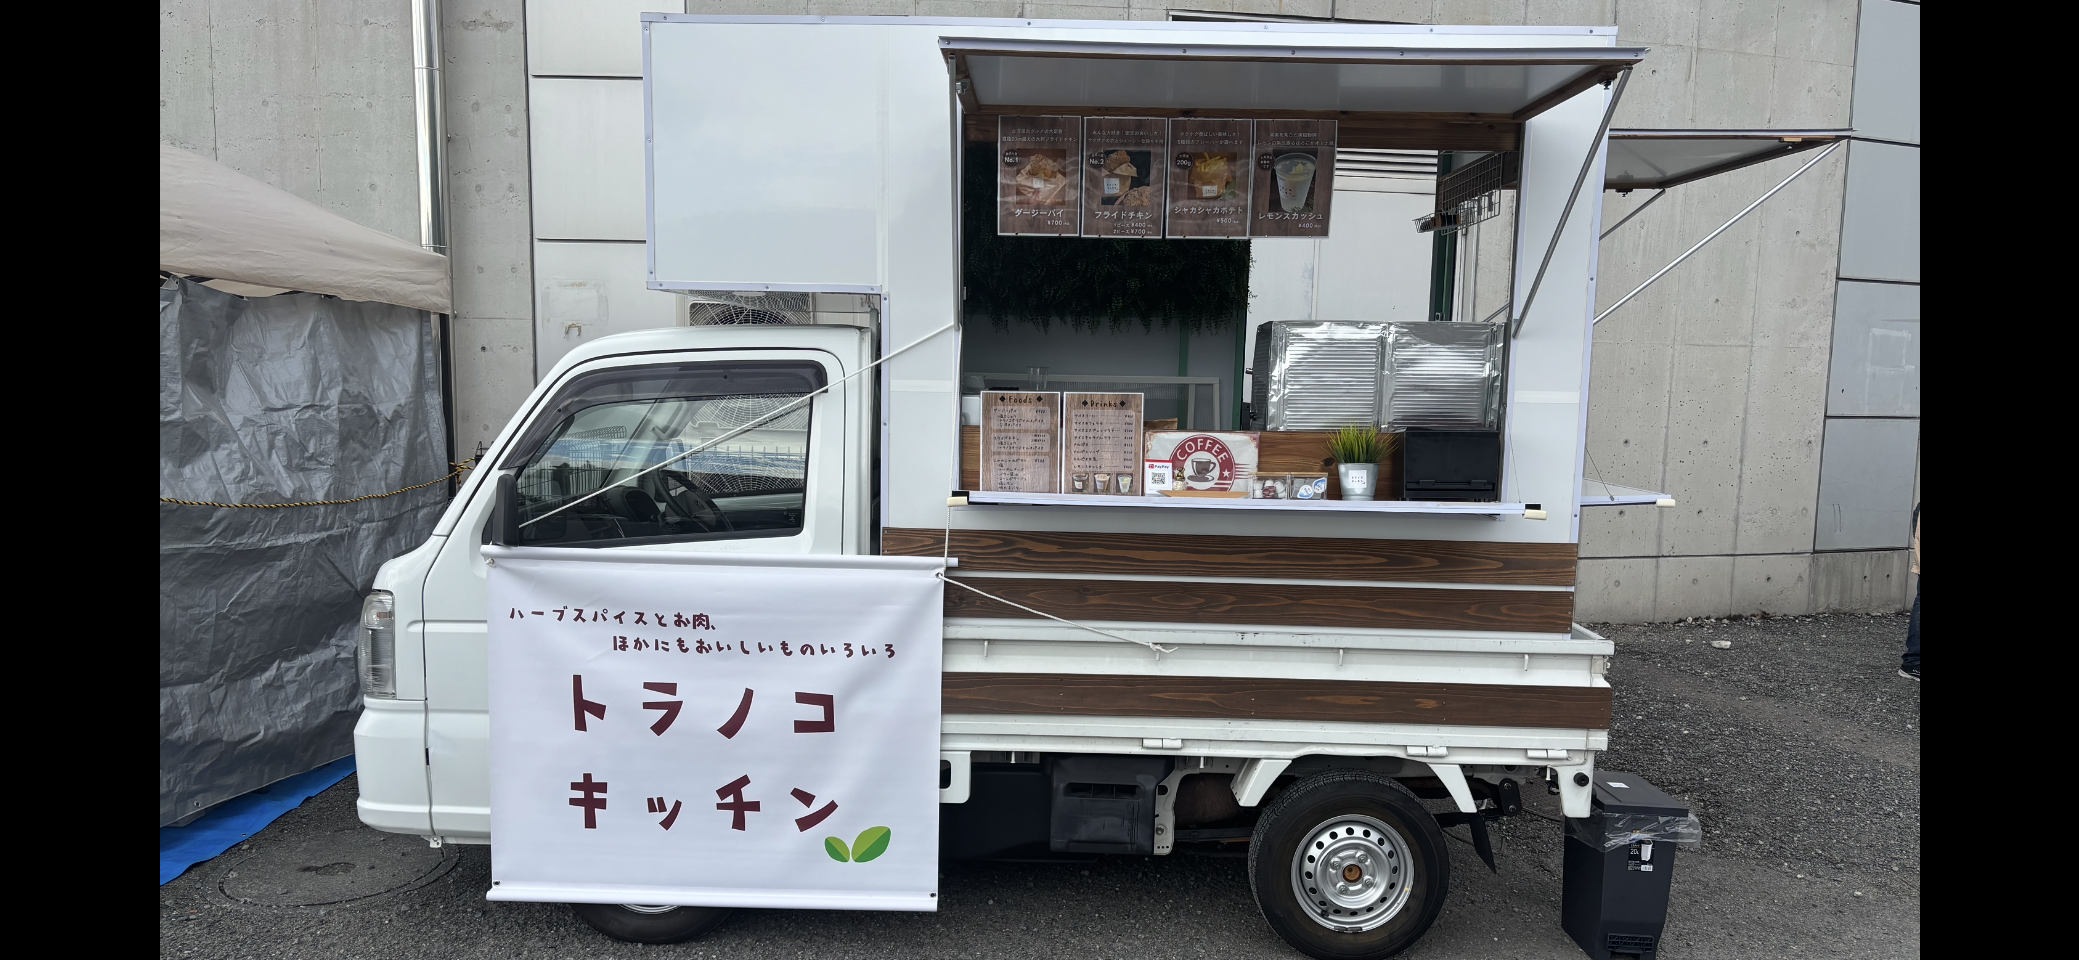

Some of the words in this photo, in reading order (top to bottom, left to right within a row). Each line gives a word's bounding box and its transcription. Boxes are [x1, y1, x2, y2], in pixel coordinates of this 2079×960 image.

[1014, 208, 1064, 218] ダージーパイ
[1094, 210, 1153, 220] フライドチキン
[1174, 206, 1243, 215] シャカシャカポテト
[1258, 212, 1323, 220] レモンスカッシュ
[1008, 395, 1032, 404] Foods
[1176, 438, 1229, 463] COFFEE
[508, 606, 718, 631] ハーブスパイスとお肉、
[612, 635, 897, 659] ほかにもおいしいものいろいろ
[571, 673, 836, 740] トラノコ
[568, 772, 839, 832] キッチン
